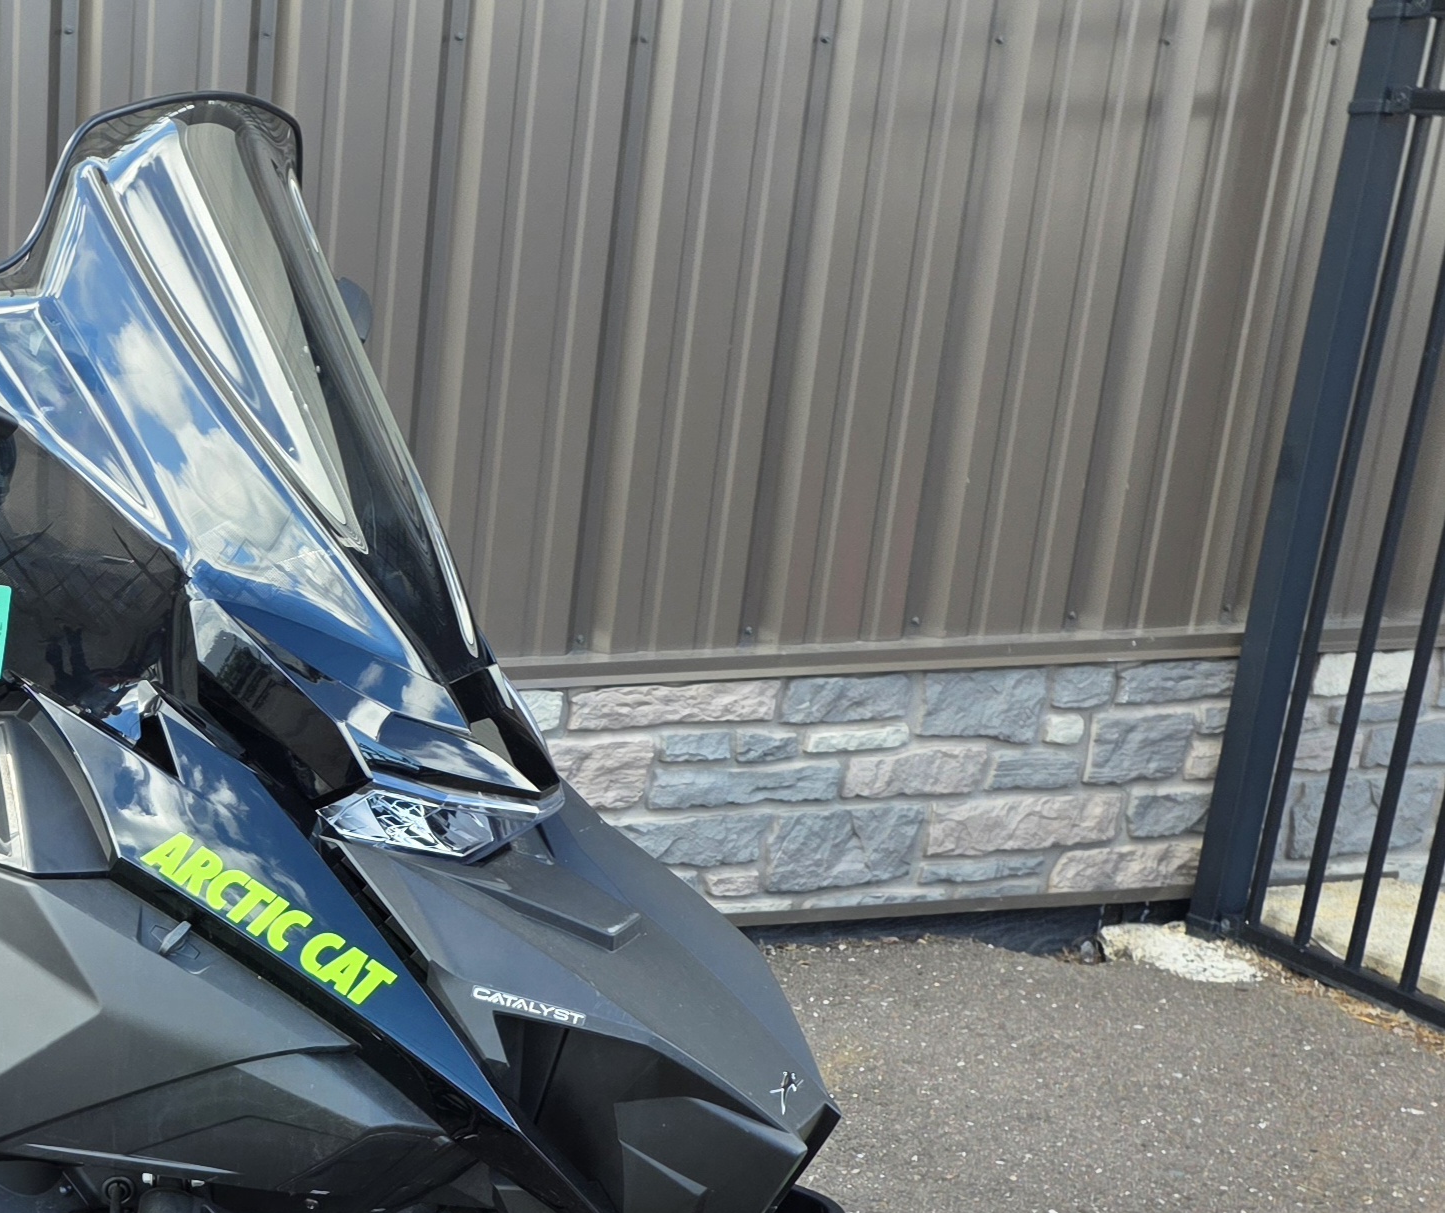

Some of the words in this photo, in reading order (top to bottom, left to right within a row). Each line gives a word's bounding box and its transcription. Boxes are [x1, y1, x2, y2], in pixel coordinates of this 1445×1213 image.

[140, 832, 313, 952] ARCTIC
[299, 932, 398, 1005] CAT
[472, 986, 585, 1025] CATALYST
